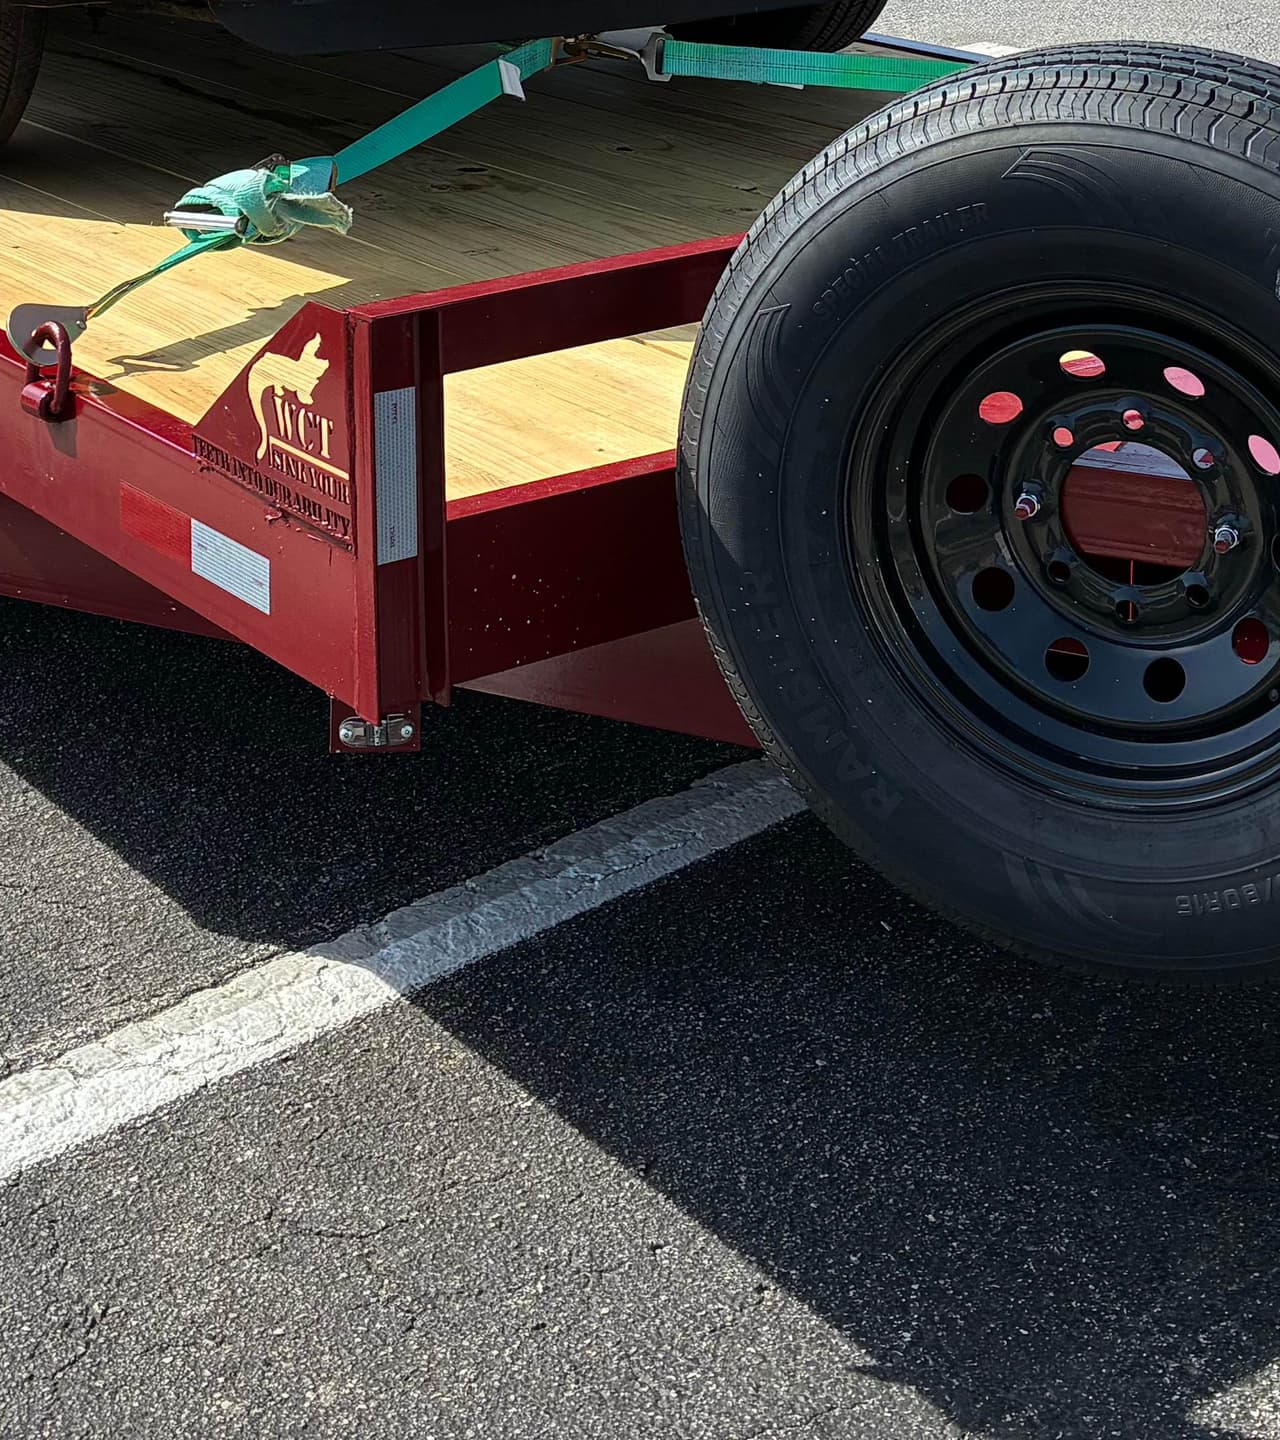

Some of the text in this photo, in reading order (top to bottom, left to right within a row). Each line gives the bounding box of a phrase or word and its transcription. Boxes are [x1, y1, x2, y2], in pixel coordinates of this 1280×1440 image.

[890, 201, 992, 262] TRAILER
[273, 396, 334, 459] WCT
[264, 474, 351, 537] DURABILITY
[272, 449, 350, 505] SINK YOUR
